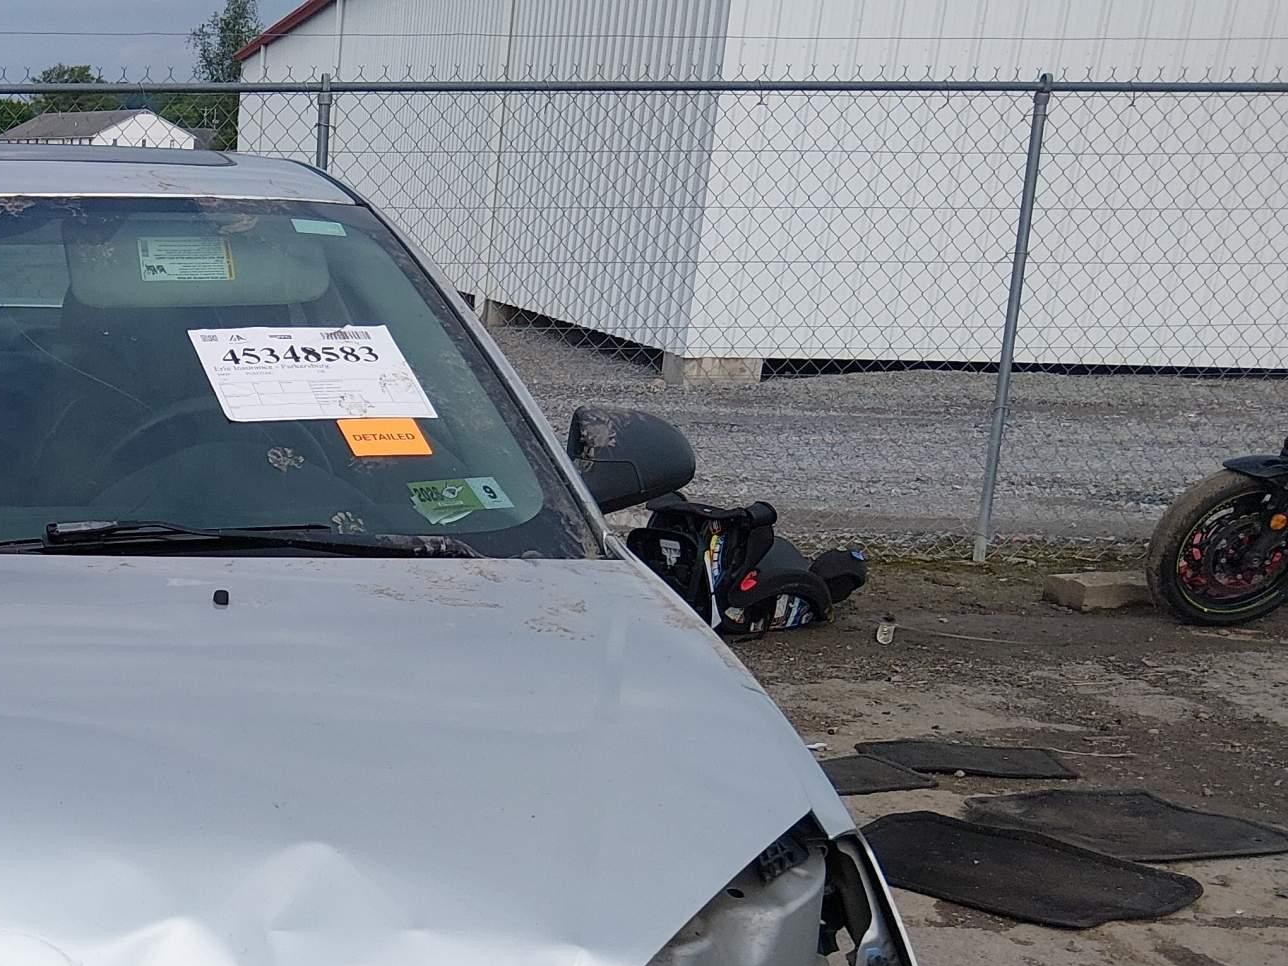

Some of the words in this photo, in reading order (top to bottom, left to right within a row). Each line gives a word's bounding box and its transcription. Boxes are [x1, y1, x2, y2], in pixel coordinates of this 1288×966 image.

[222, 345, 379, 365] 45348583
[352, 432, 416, 442] DETAILED
[482, 485, 498, 499] 9
